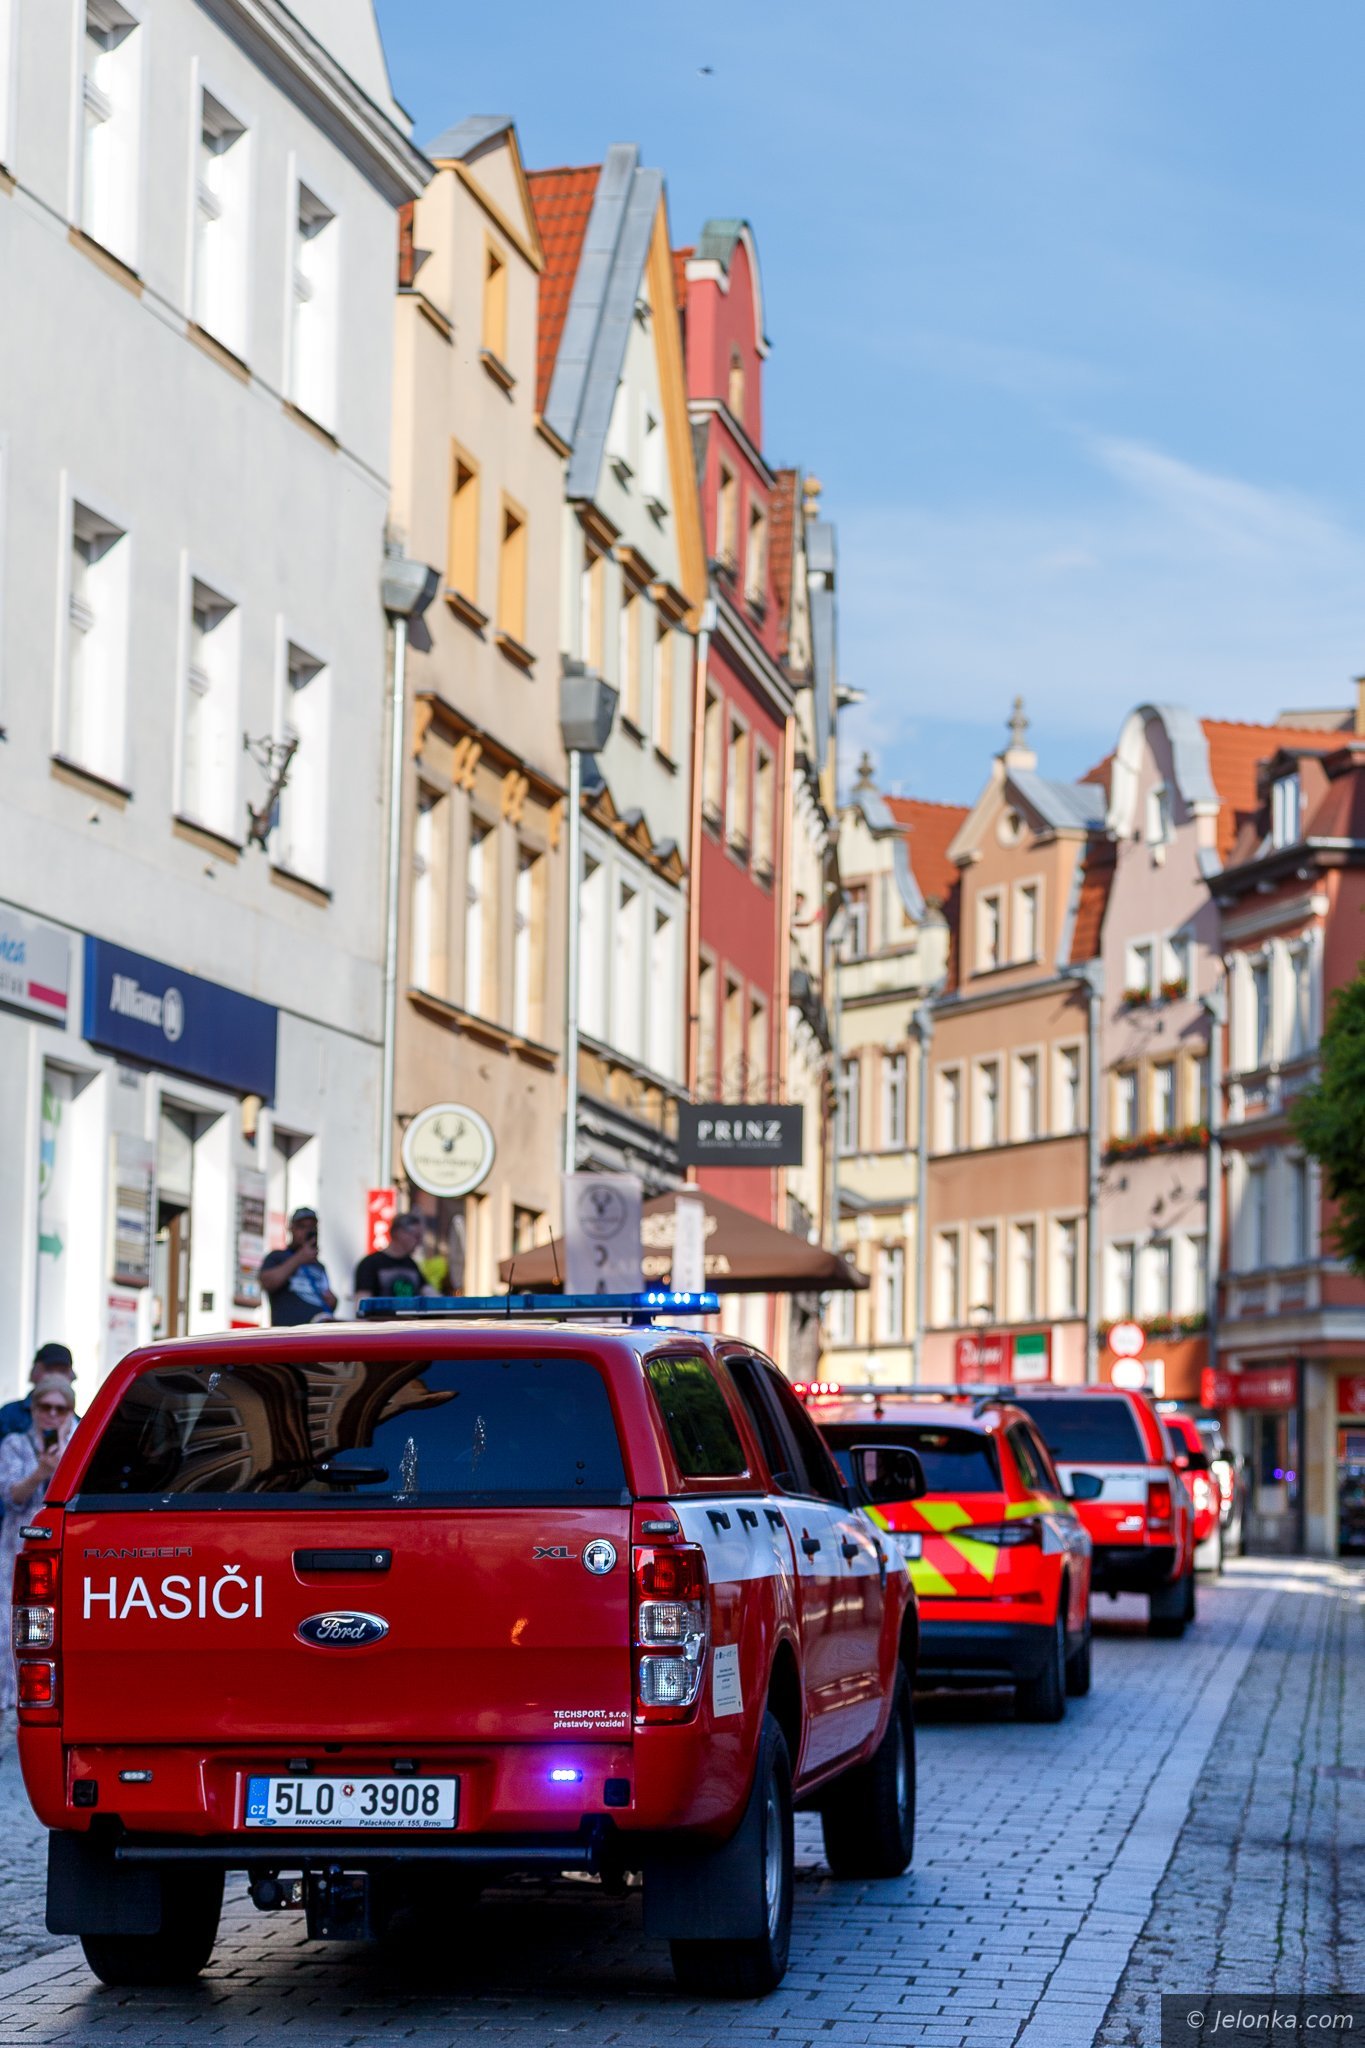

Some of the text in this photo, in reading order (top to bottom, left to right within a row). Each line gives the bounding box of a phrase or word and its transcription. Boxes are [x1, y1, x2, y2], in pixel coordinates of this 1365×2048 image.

[110, 973, 162, 1027] Allianz
[697, 1119, 783, 1141] PRINZ
[83, 1547, 192, 1559] RANGER
[532, 1546, 577, 1559] XL
[83, 1564, 263, 1620] HASIČI
[316, 1614, 365, 1640] Ford
[553, 1710, 607, 1719] TECHSPORT,
[553, 1720, 625, 1729] přestavby vozidel
[275, 1783, 440, 1816] 5L0 3908
[250, 1804, 265, 1815] CZ
[359, 1819, 396, 1827] Palackého
